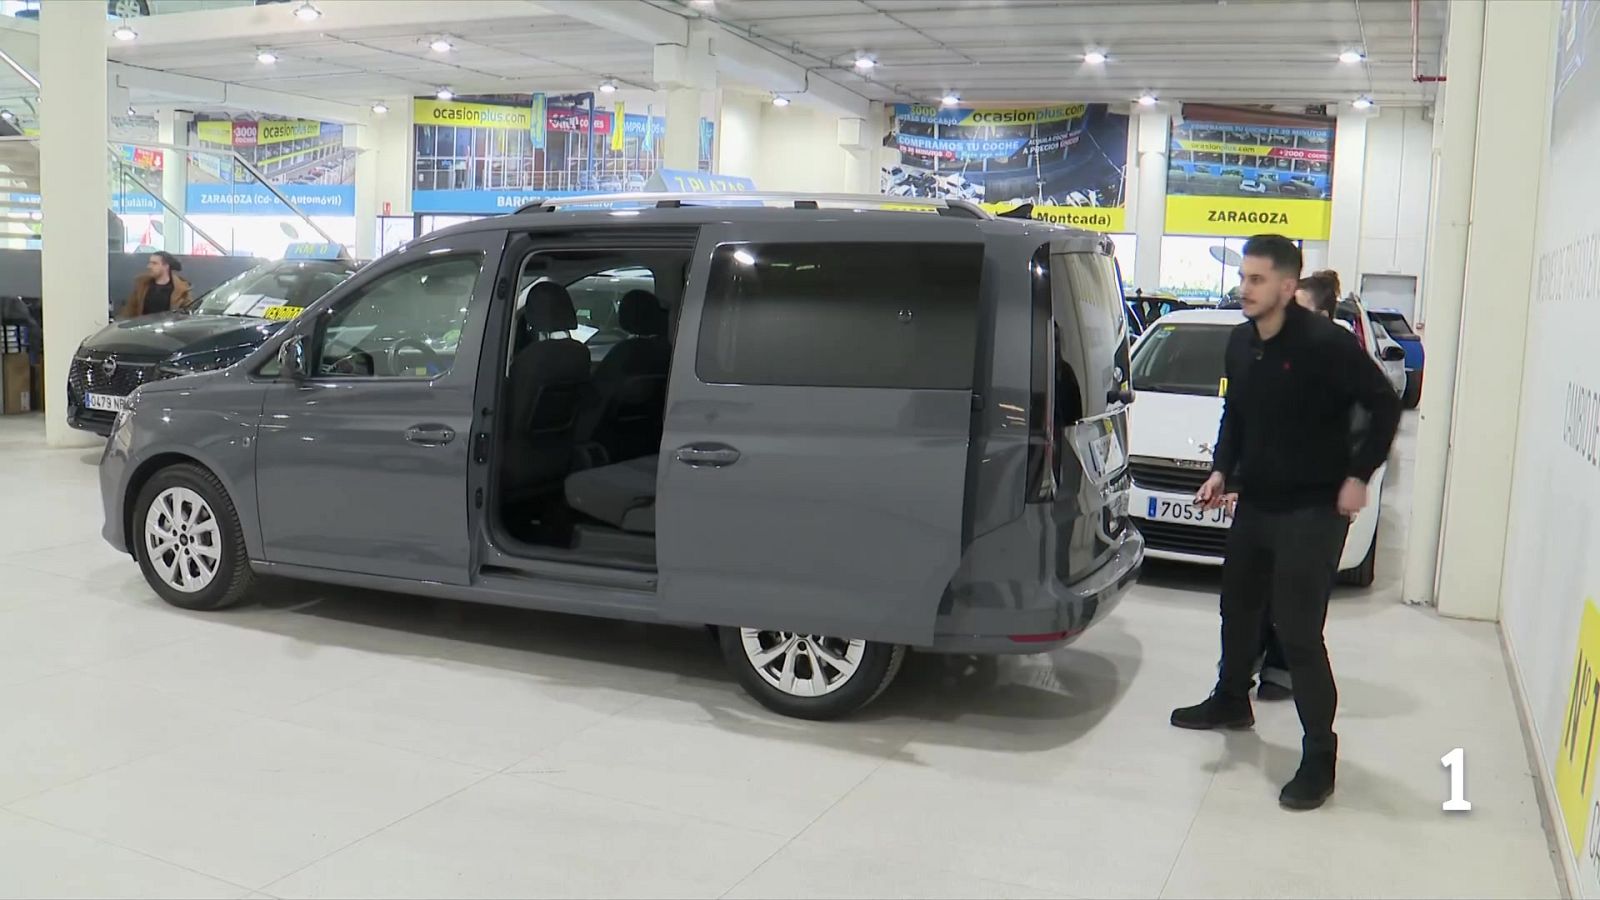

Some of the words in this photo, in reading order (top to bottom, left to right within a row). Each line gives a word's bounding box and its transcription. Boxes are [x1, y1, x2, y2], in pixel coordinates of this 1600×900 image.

[433, 106, 526, 124] ocasionplus.com
[972, 103, 1085, 122] ocasionplus.com
[898, 136, 964, 151] COMPRAMOS
[967, 142, 980, 152] TU
[982, 141, 1020, 152] COCHE
[201, 193, 252, 204] ZARAGOZA
[1037, 212, 1111, 228] Montcada)
[1208, 210, 1288, 224] ZARAGOZA
[1160, 500, 1205, 522] 7053
